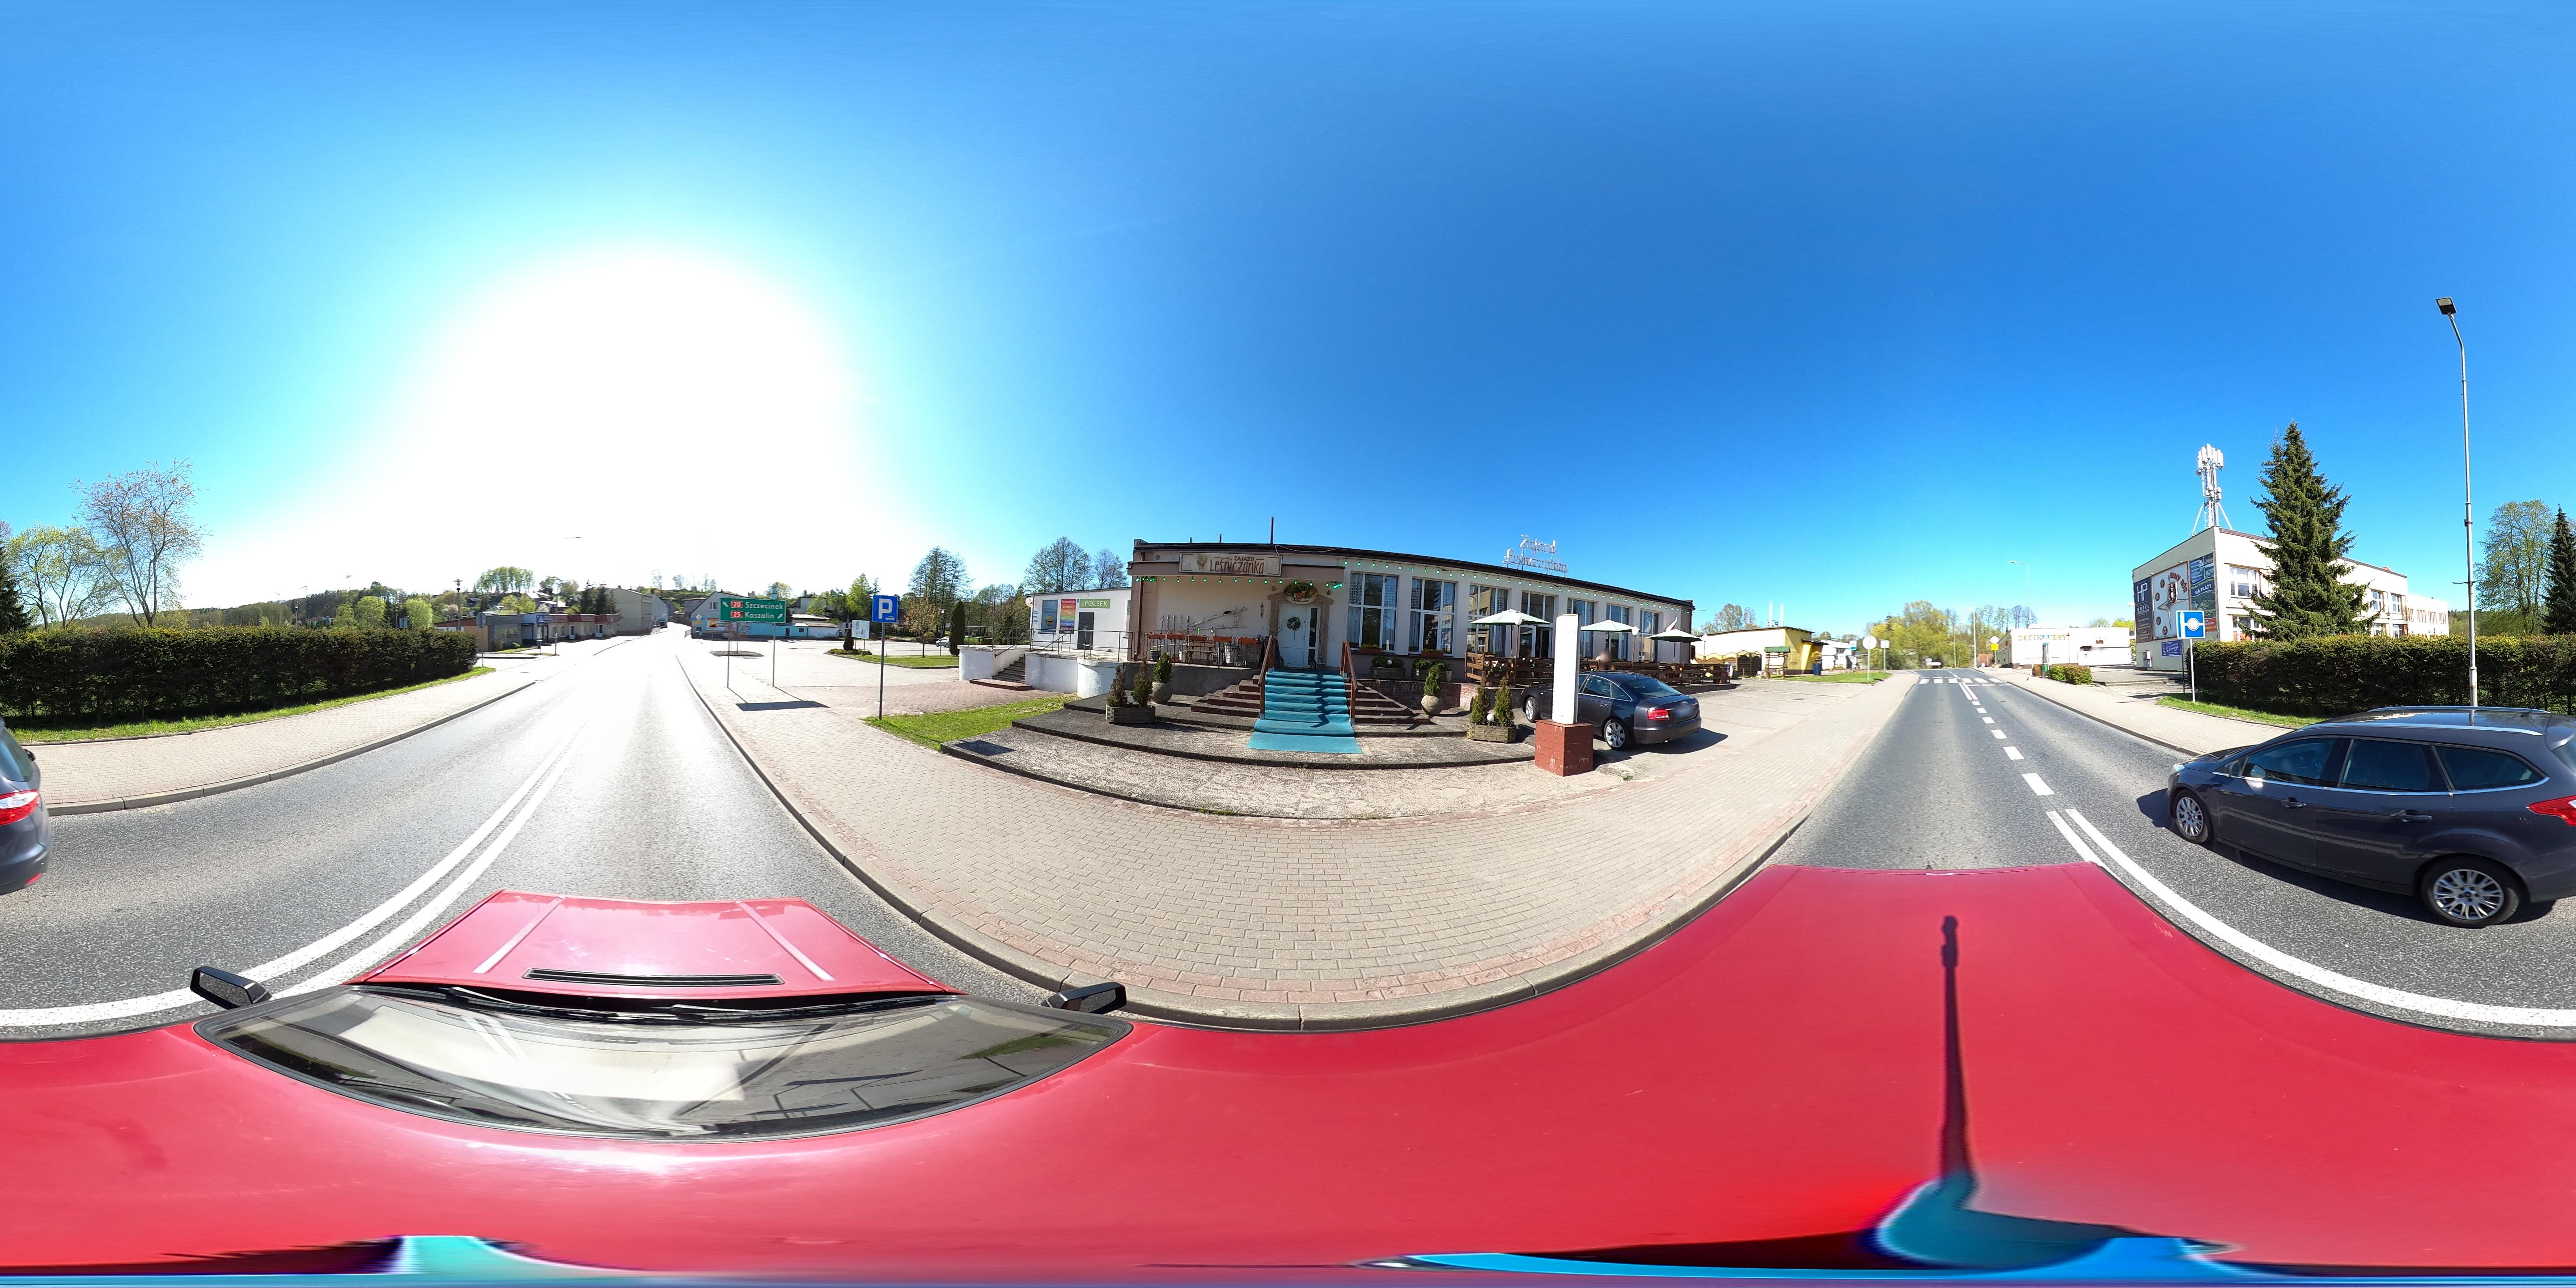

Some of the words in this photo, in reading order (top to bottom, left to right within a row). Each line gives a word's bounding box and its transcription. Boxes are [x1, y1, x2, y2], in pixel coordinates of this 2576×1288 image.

[1210, 559, 1264, 574] Leśniczanka
[2200, 584, 2212, 592] PLAŻY
[878, 598, 893, 619] P
